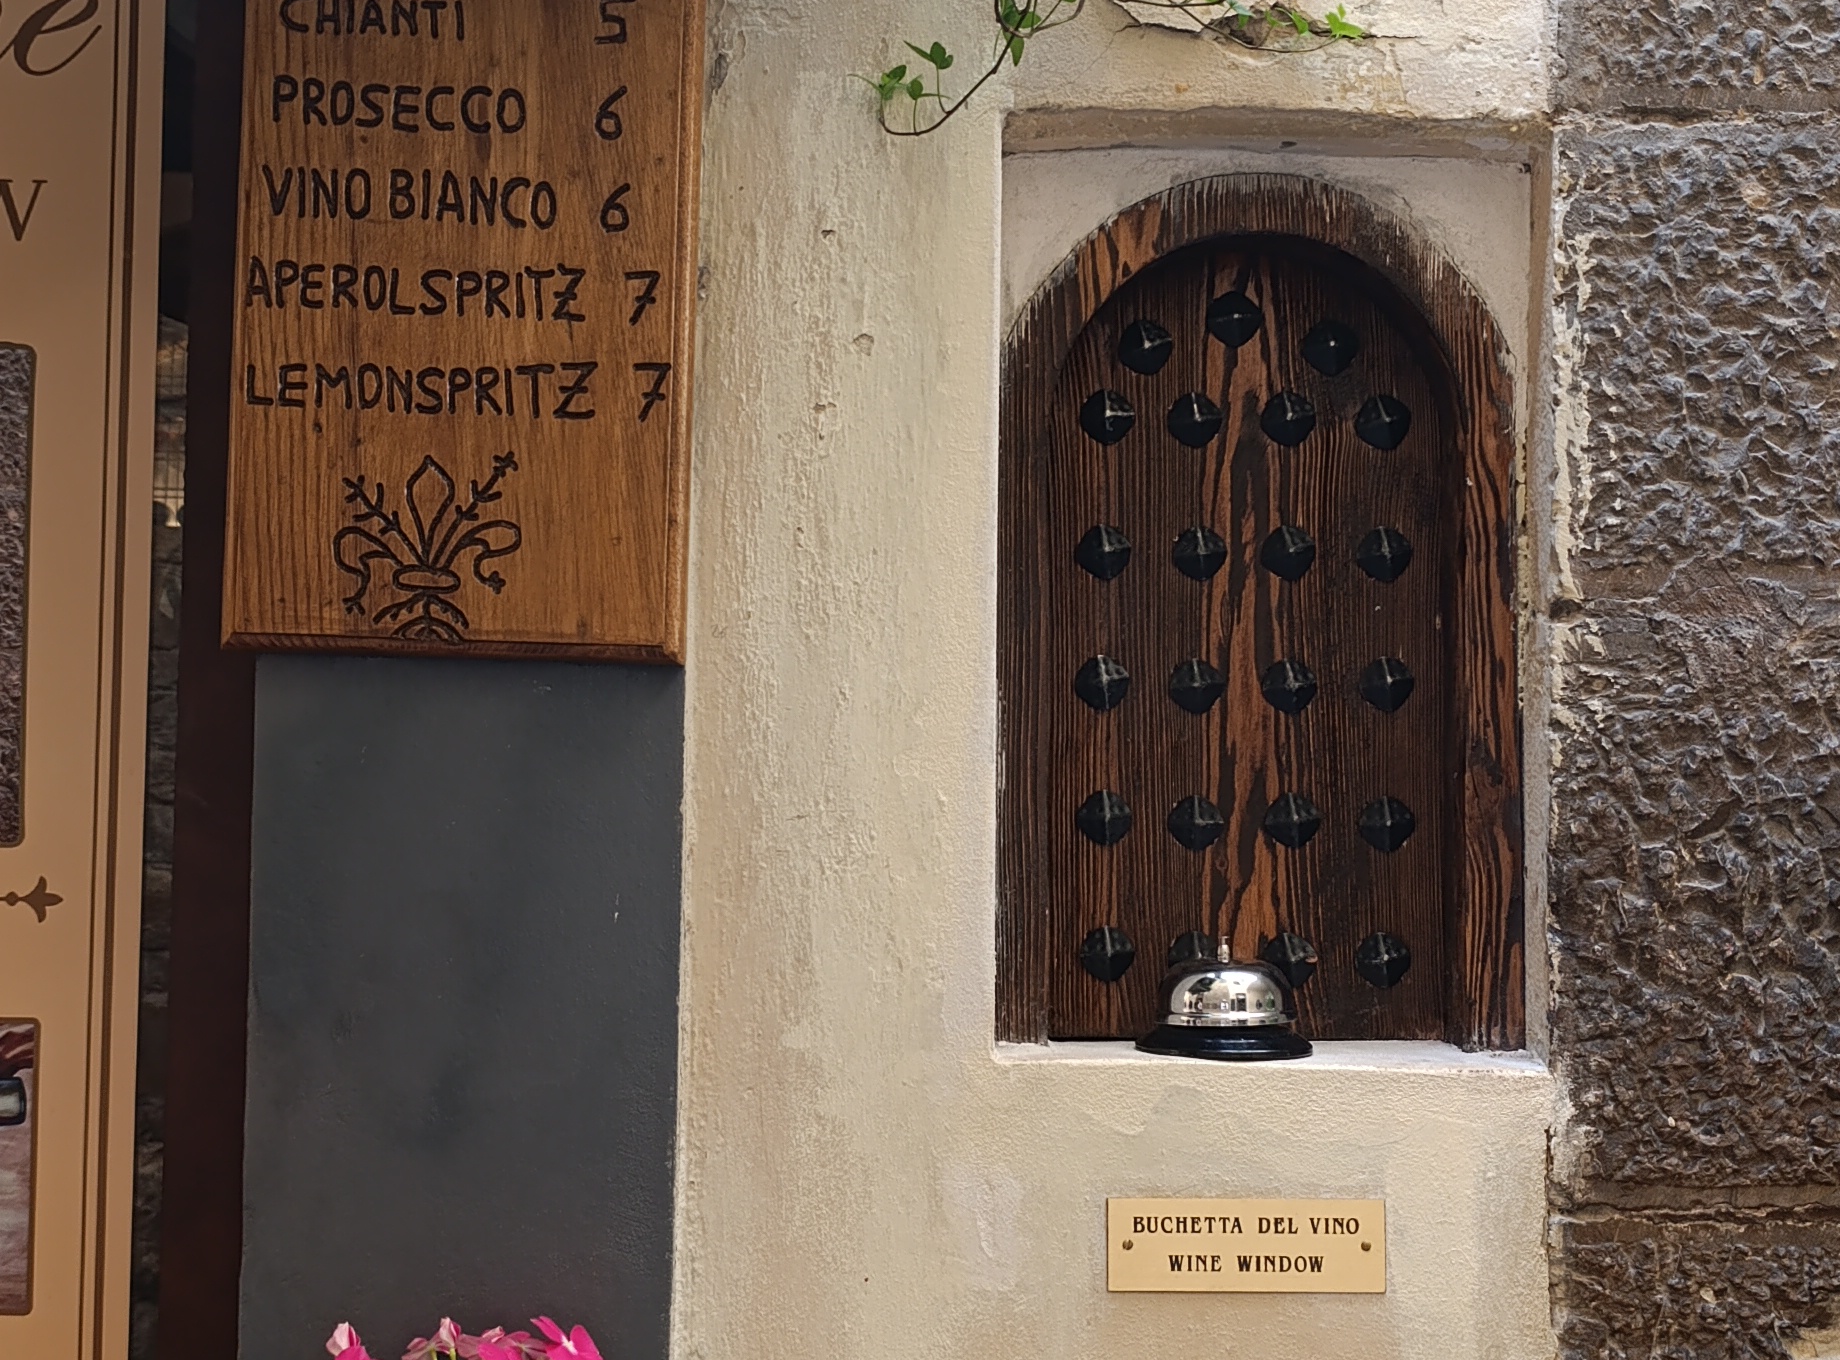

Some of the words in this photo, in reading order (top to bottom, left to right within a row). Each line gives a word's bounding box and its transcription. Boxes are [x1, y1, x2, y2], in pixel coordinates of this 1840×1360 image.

[272, 74, 526, 134] PROSECCO
[595, 86, 628, 140] 6
[262, 164, 371, 220] VINO
[388, 169, 557, 230] BIANCO
[600, 183, 631, 233] 6
[246, 256, 586, 322] APEROLSPRITZ
[624, 270, 661, 325] 7
[246, 361, 598, 419] LEMONSPRITZ
[633, 362, 671, 421] 7
[1132, 1216, 1243, 1234] BUCHETTA
[1258, 1217, 1298, 1235] DEL
[1309, 1217, 1360, 1235] VINO
[1168, 1255, 1222, 1272] WINE
[1237, 1255, 1324, 1273] WINDOW
